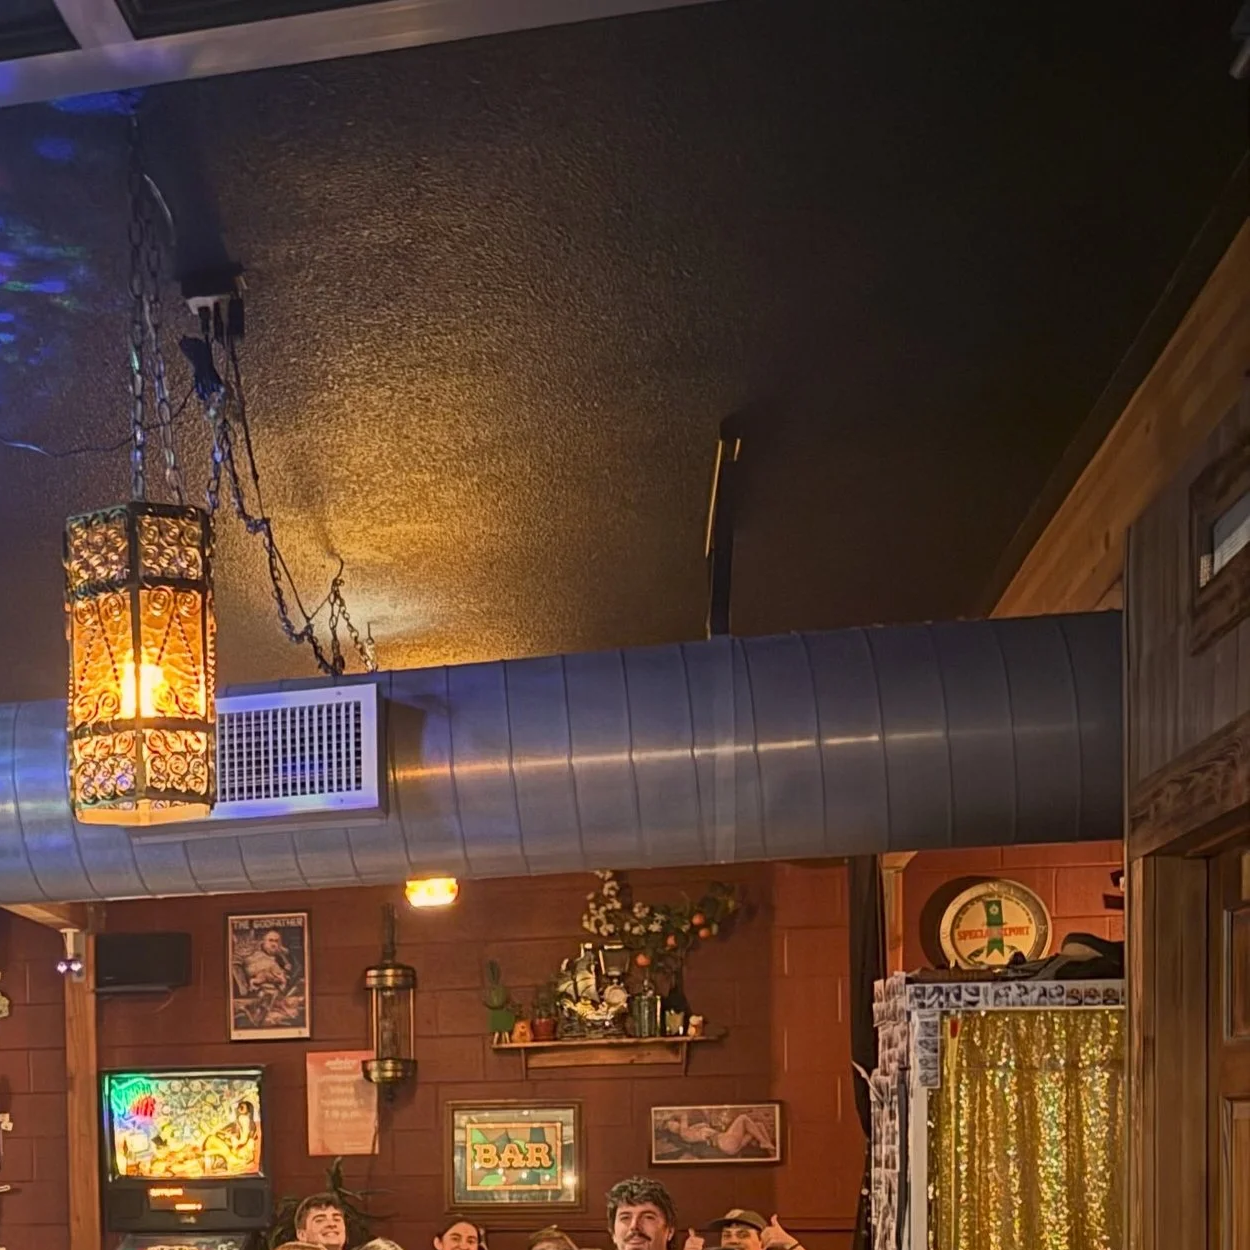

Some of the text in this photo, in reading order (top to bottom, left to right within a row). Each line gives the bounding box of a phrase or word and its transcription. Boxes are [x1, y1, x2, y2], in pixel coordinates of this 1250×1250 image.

[233, 917, 304, 930] THE GODFATHER
[473, 1143, 553, 1169] BAR
